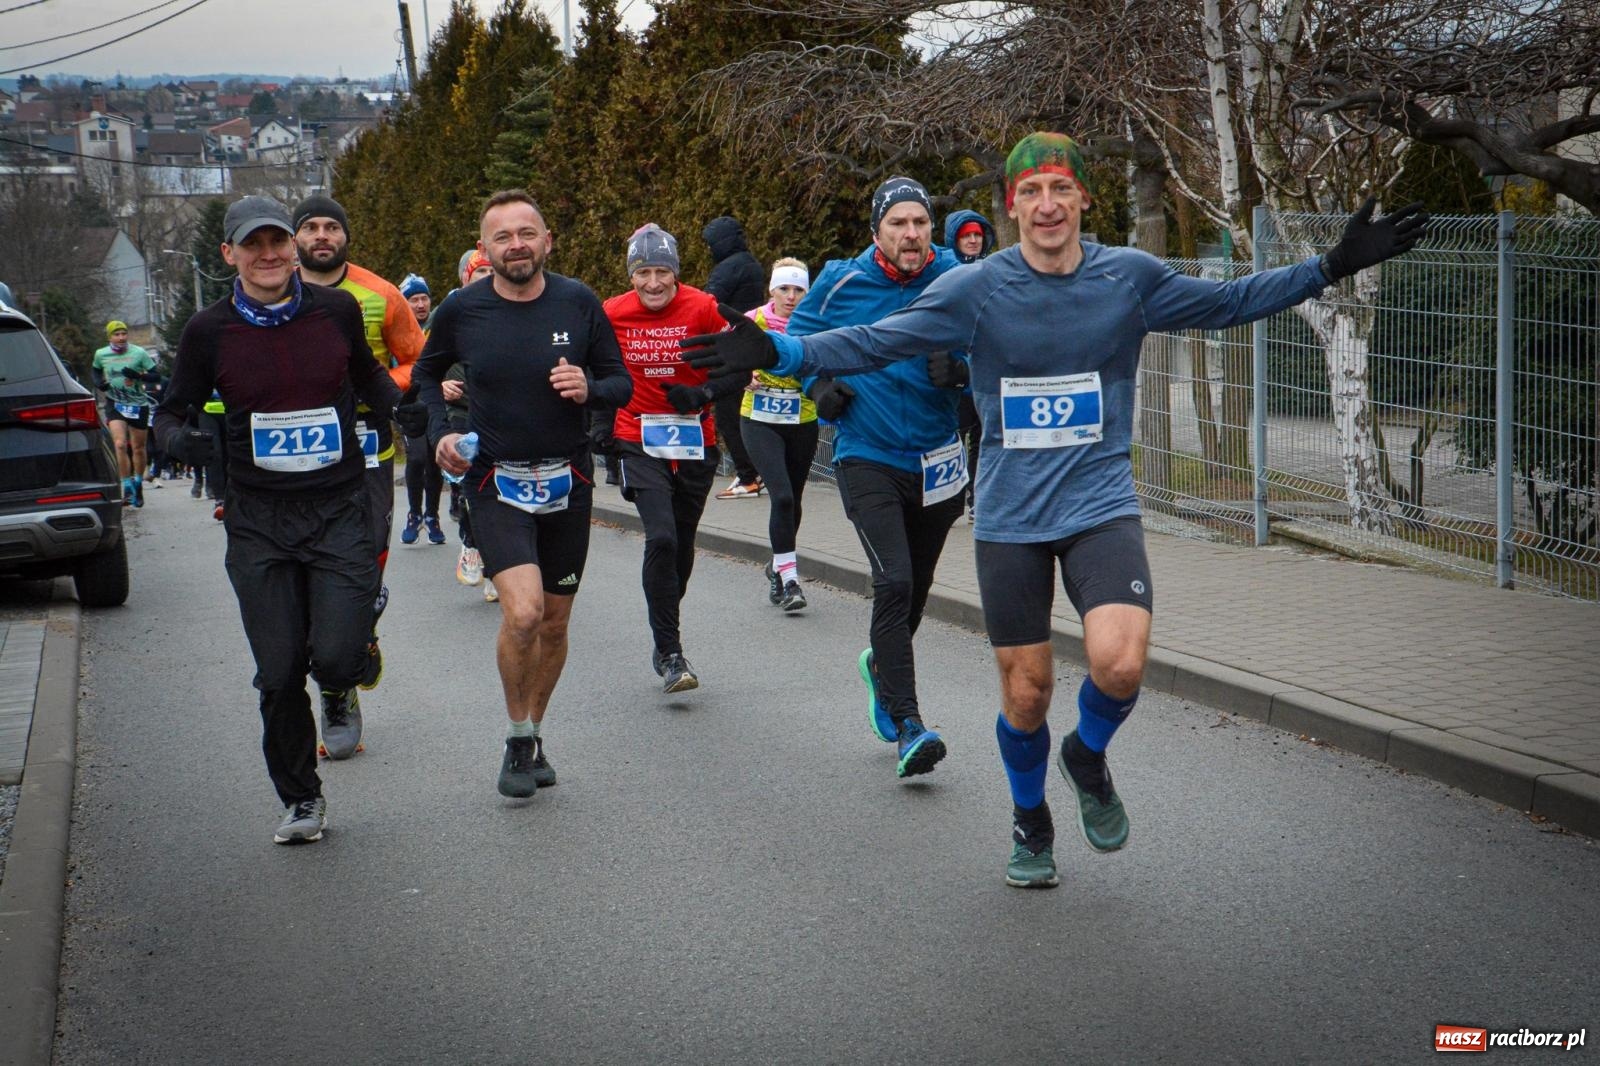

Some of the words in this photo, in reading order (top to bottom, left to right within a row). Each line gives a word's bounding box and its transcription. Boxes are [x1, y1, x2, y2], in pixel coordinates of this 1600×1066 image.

[626, 329, 630, 338] I
[632, 329, 644, 338] TY
[645, 326, 688, 337] MOŻESZ
[626, 339, 681, 350] URATOWA
[625, 350, 660, 362] KOMUŚ
[661, 350, 683, 362] ŻYC
[644, 367, 667, 375] DKMS
[761, 396, 793, 414] 152
[1031, 396, 1075, 427] 89
[269, 426, 327, 454] 212
[667, 425, 680, 446] 2
[517, 480, 551, 503] 35
